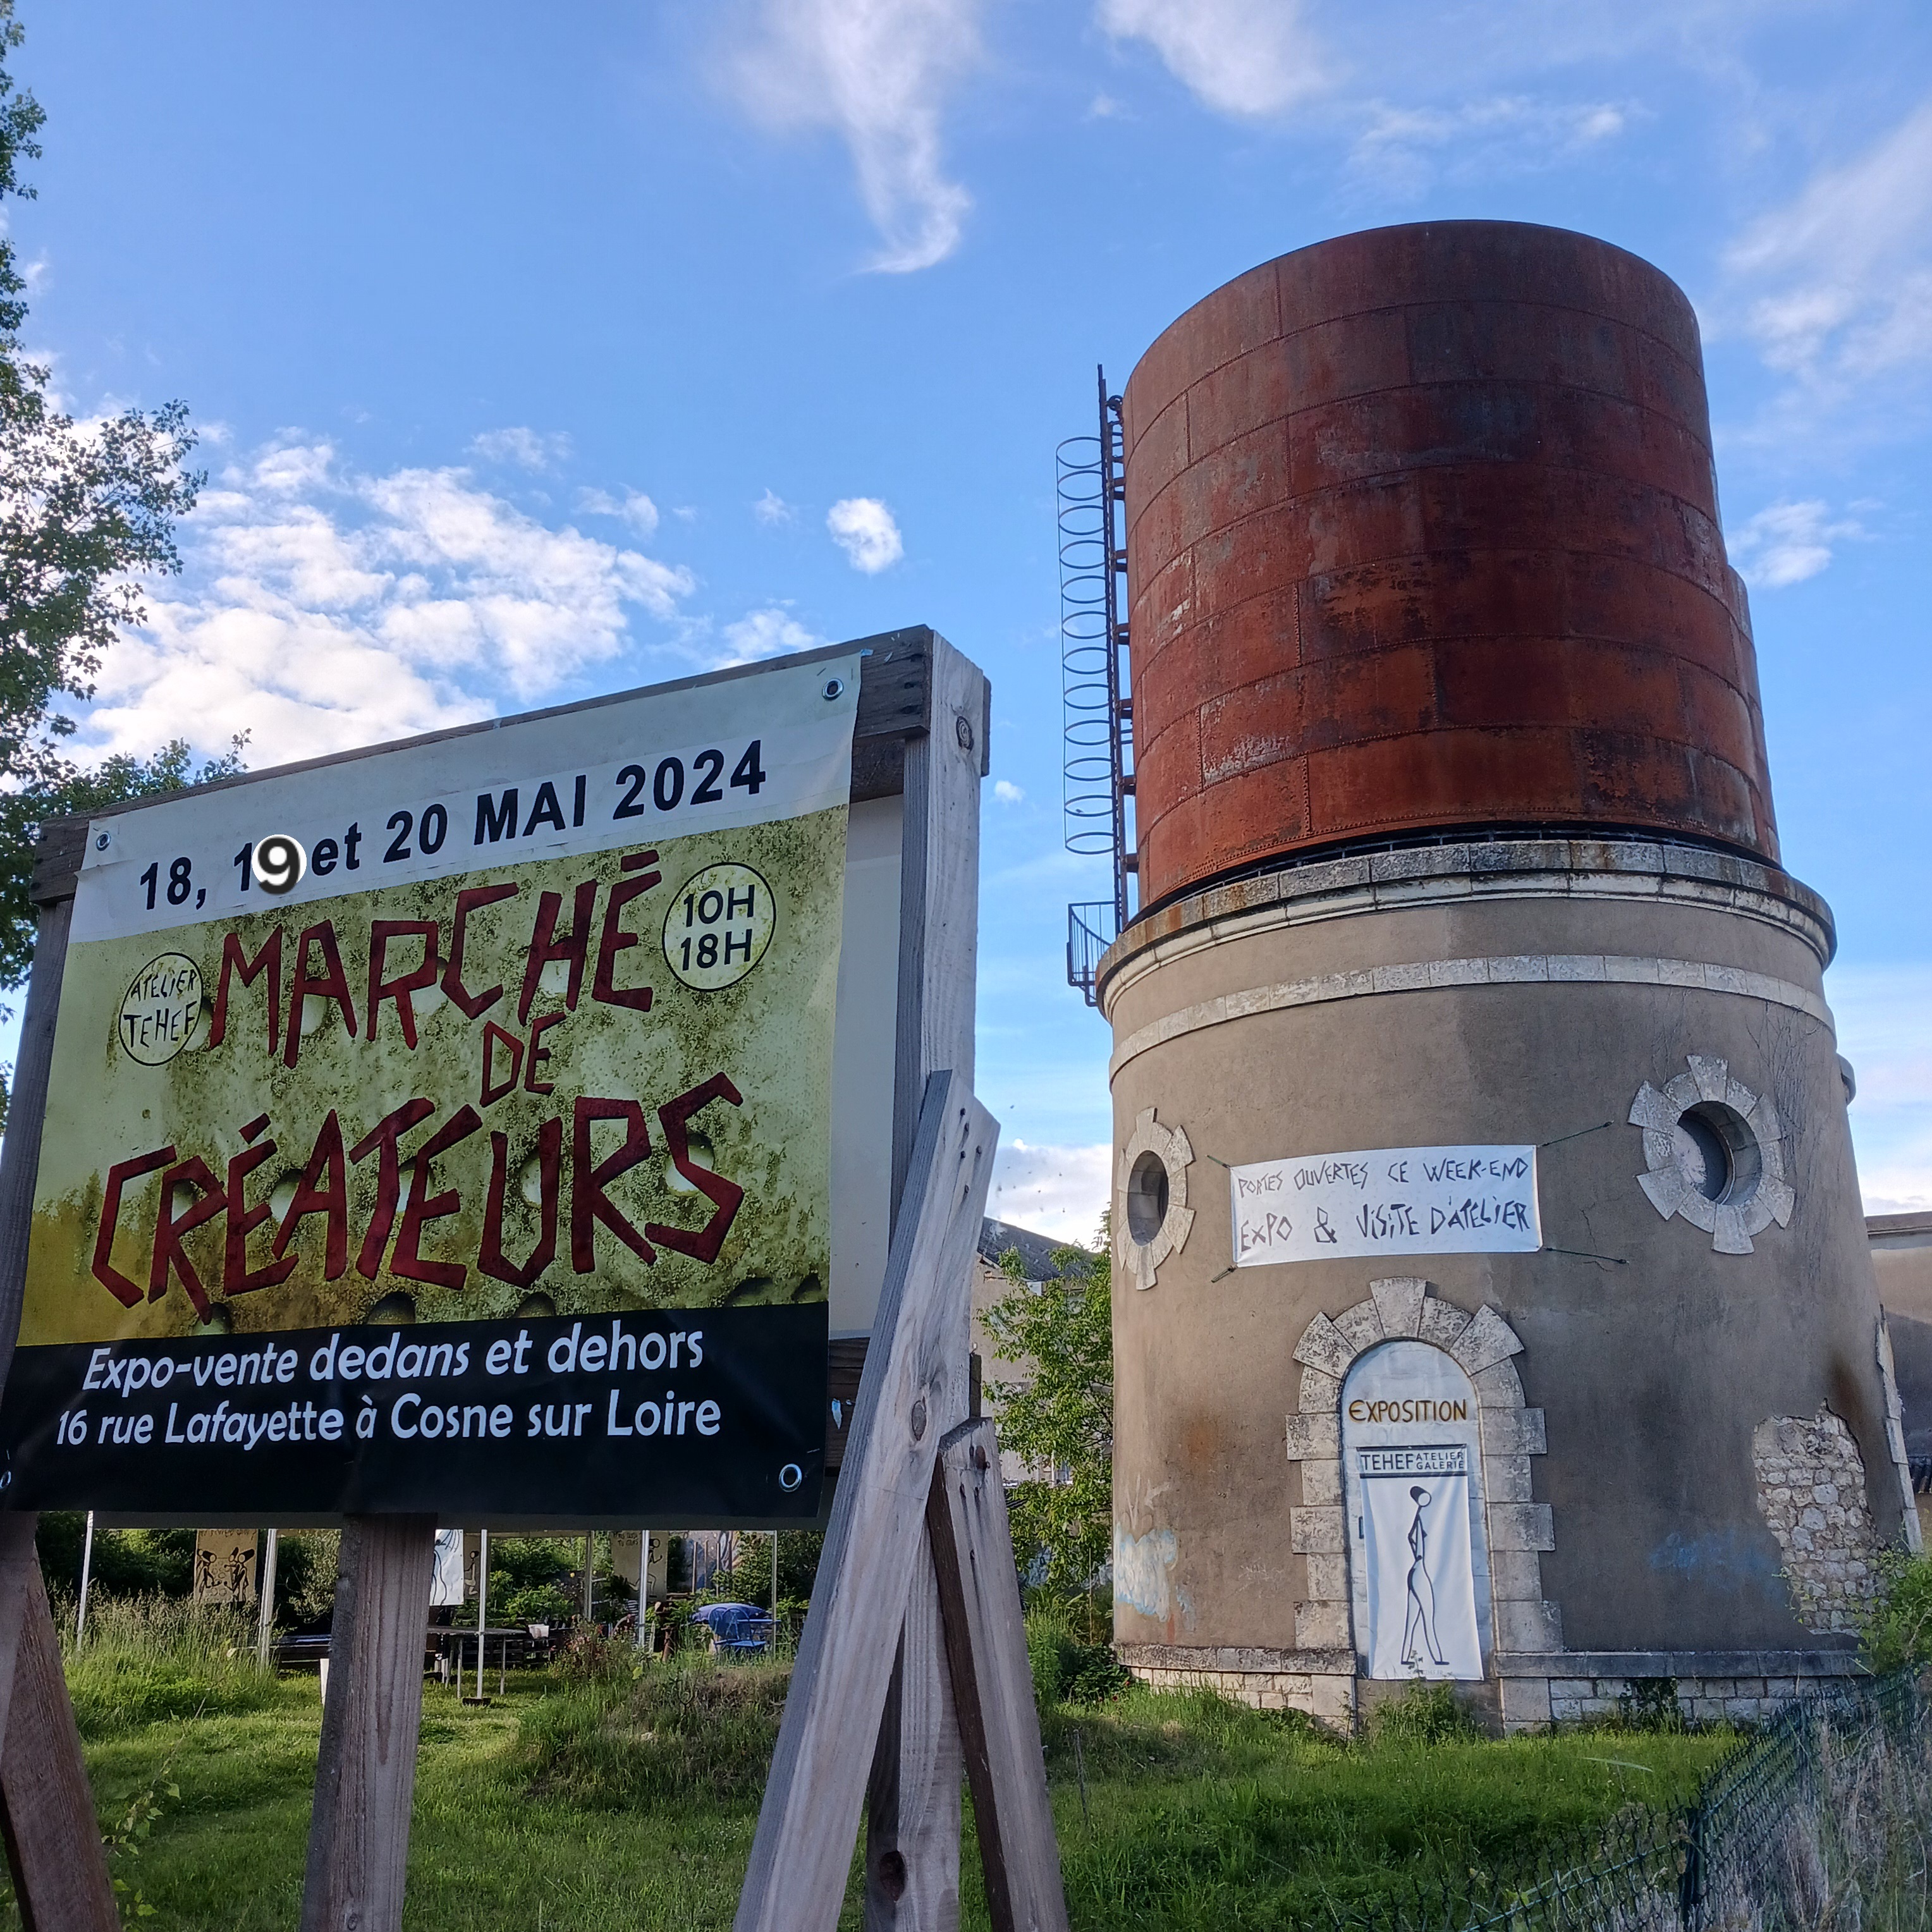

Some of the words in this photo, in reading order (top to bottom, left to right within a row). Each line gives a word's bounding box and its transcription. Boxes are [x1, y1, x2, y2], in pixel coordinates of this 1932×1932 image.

[140, 857, 206, 910] 18,
[311, 822, 362, 876] et
[382, 803, 448, 863] 20
[474, 773, 587, 845] MAI
[612, 739, 766, 820] 2024
[683, 884, 755, 927] 10H
[209, 849, 663, 1069] MARCHÉ
[680, 929, 752, 971] 18H
[131, 969, 197, 1002] ATELIER
[123, 1001, 197, 1048] TEHEF
[480, 1011, 567, 1107] DE
[92, 1072, 745, 1326] CRÉATEURS
[1237, 1170, 1285, 1198] PORTES
[1293, 1159, 1369, 1189] OUVERTES
[1388, 1160, 1409, 1183] CE
[1424, 1156, 1529, 1182] WEEK-END
[1240, 1211, 1293, 1252] EXPO
[1313, 1206, 1338, 1244] &
[82, 1342, 299, 1398] Expo-vente
[310, 1331, 470, 1381] dedans
[485, 1329, 533, 1375] et
[547, 1319, 703, 1373] dehors
[56, 1409, 87, 1445] 16
[97, 1414, 154, 1444] rue
[164, 1400, 345, 1451] Lafayette
[355, 1394, 378, 1439] à
[391, 1392, 513, 1439] Cosne
[527, 1400, 592, 1437] sur
[607, 1388, 722, 1436] Loire
[1348, 1399, 1467, 1422] EXPOSITION
[1360, 1453, 1414, 1470] TEHEF
[1415, 1451, 1464, 1461] ATELIER
[1416, 1460, 1465, 1470] GALERIE
